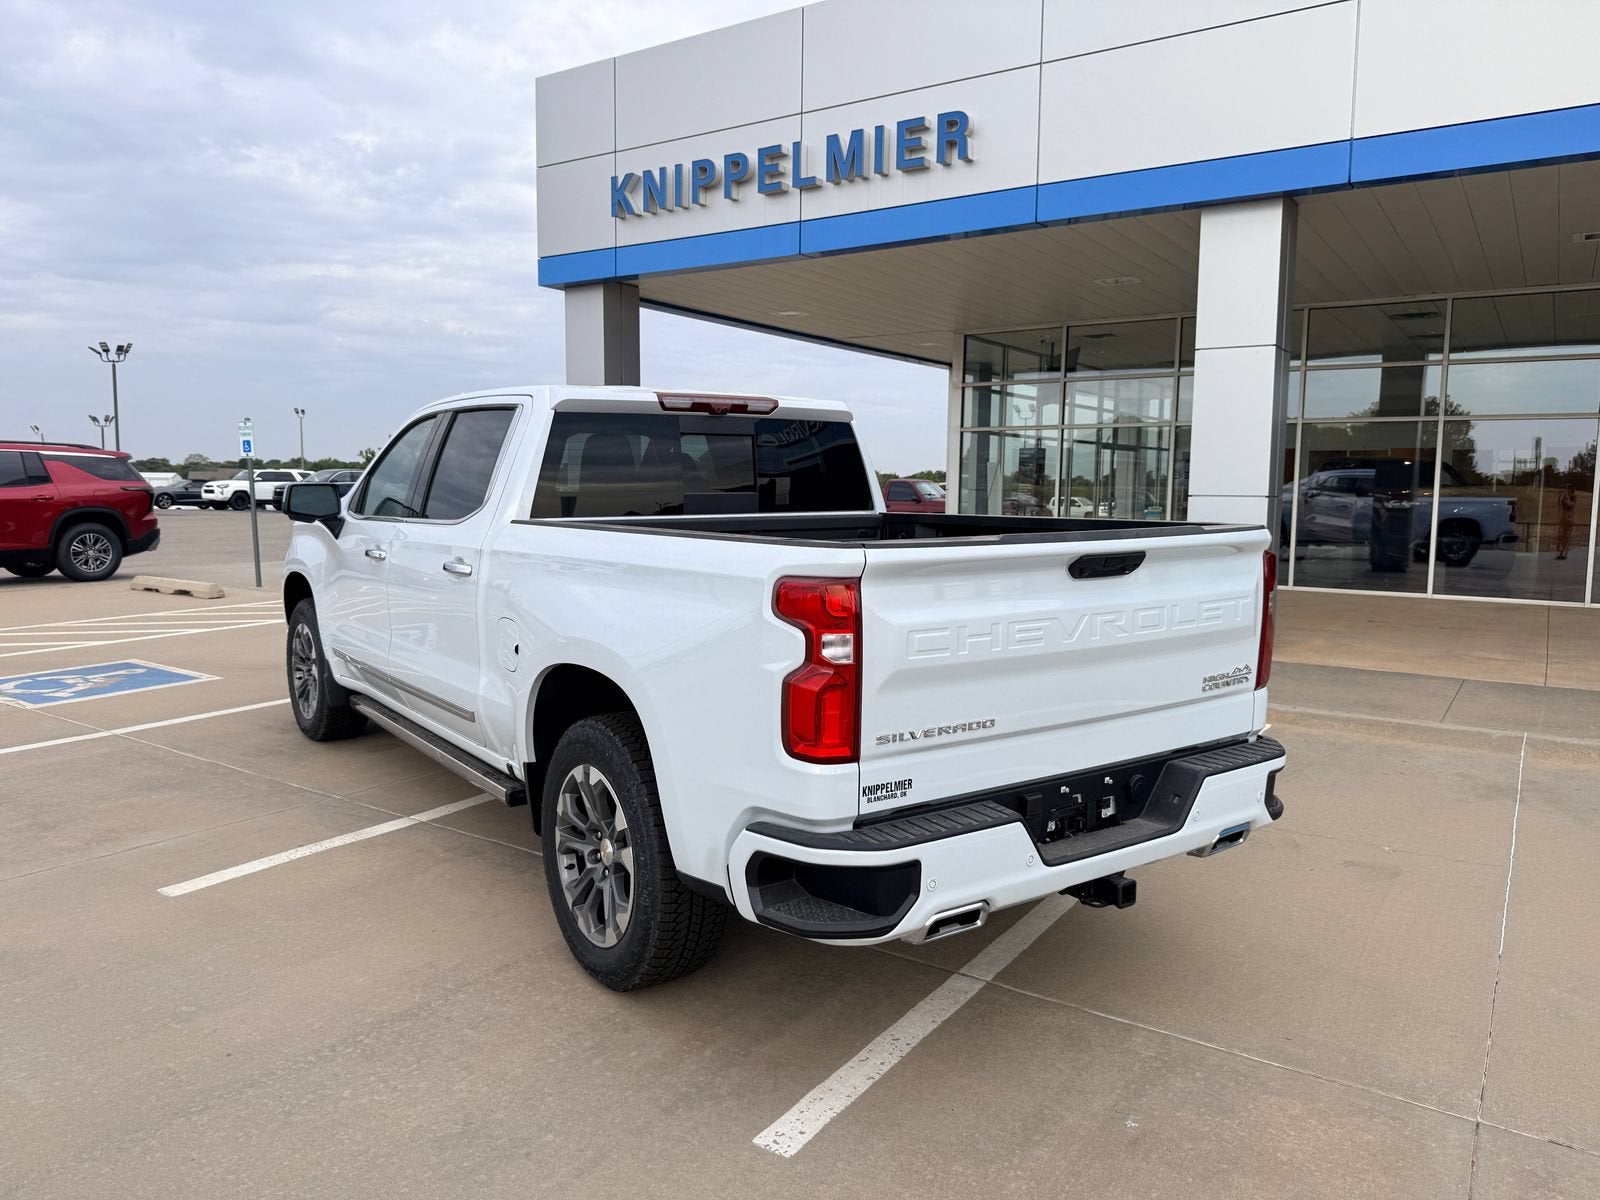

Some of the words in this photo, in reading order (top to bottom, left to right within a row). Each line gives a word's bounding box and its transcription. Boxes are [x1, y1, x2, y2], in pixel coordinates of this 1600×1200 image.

[611, 110, 971, 218] KNIPPELMIER
[907, 596, 1250, 659] CHEVROLET
[1202, 676, 1249, 692] COUNTRY
[1203, 672, 1231, 684] HIGH
[876, 719, 995, 745] SILVERADO
[862, 779, 912, 797] KNIPPELMIER
